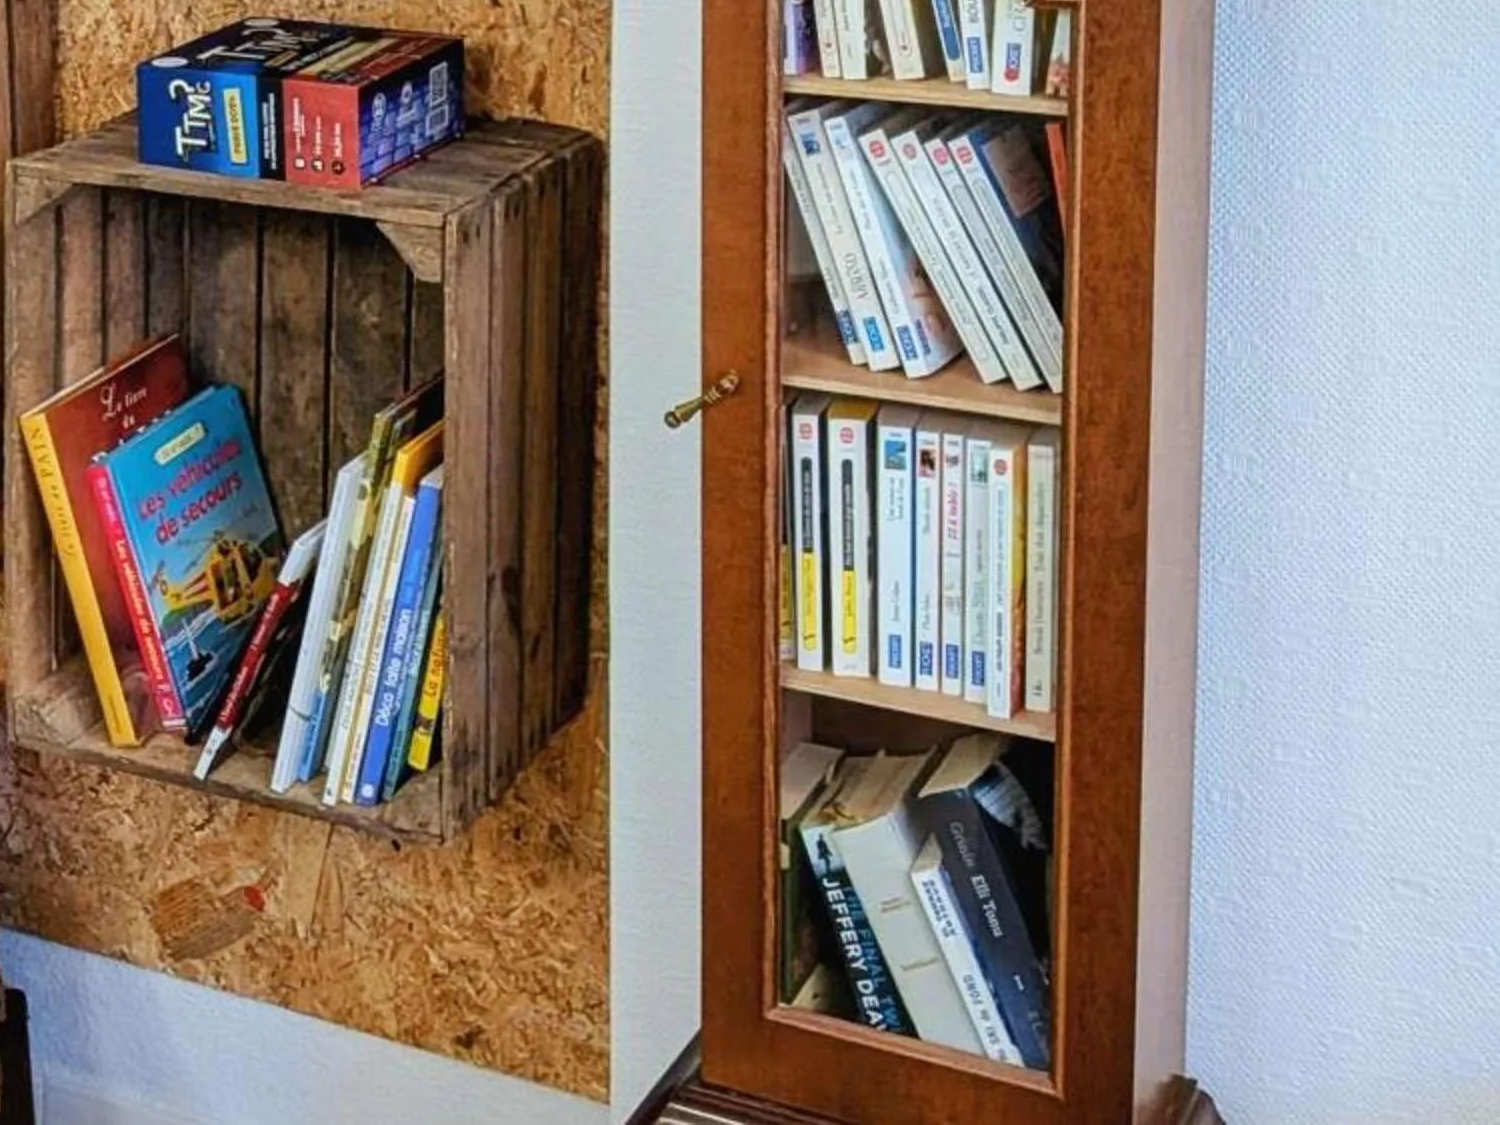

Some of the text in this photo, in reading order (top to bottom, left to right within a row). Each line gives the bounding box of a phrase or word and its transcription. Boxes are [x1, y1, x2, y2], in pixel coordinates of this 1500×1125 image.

[139, 495, 165, 519] Les
[156, 473, 242, 545] de secours
[113, 538, 130, 561] Les
[374, 689, 395, 727] Déco
[391, 607, 413, 656] maison
[820, 873, 869, 976] JEFFERY
[856, 926, 888, 987] FINAL
[960, 971, 984, 1007] FOND
